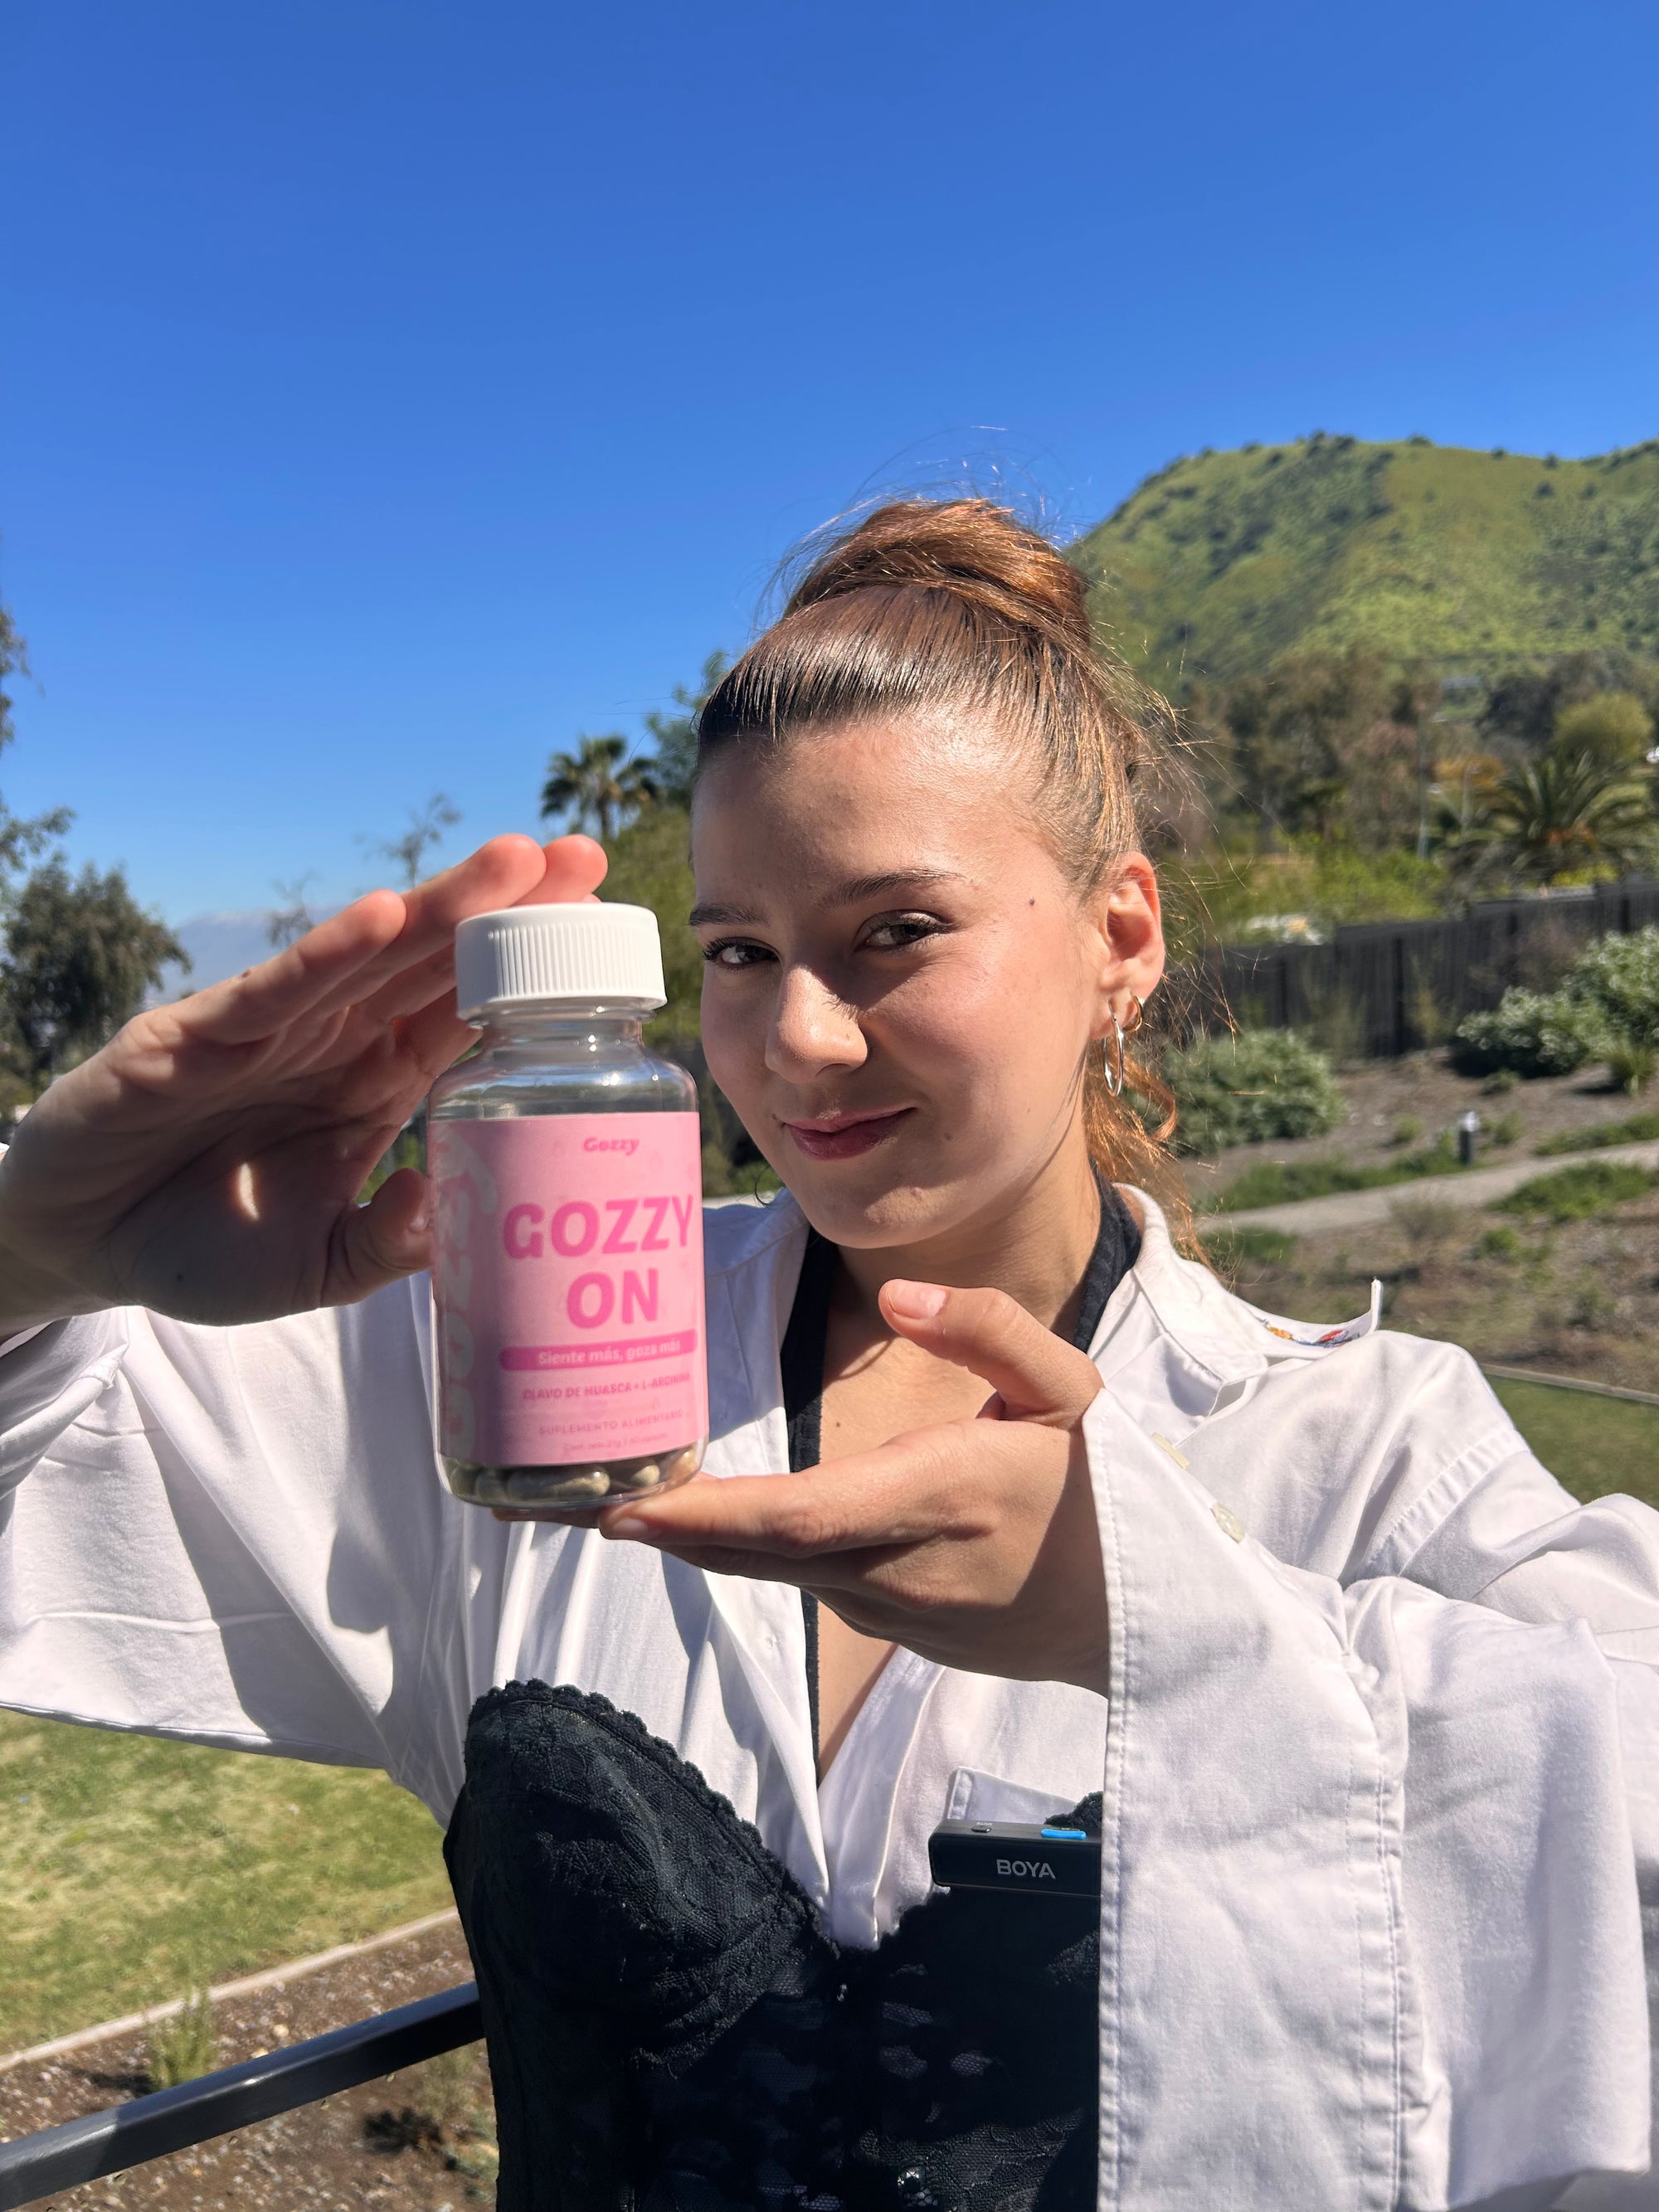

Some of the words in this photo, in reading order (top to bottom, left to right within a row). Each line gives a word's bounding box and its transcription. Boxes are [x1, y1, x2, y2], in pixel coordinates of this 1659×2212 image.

[583, 1137, 640, 1156] Gozzy
[503, 1194, 694, 1260] GOZZY
[567, 1266, 659, 1330] ON
[539, 1349, 586, 1365] Siente
[590, 1344, 624, 1362] más,
[627, 1344, 658, 1361] goza
[659, 1338, 681, 1354] más
[523, 1387, 562, 1400] CLAVO
[566, 1387, 580, 1398] DE
[584, 1381, 631, 1397] HUASCA
[538, 1420, 618, 1435] SUPLEMENTO
[622, 1408, 684, 1427] ALIMENTARIO
[996, 1859, 1056, 1879] BOYA
